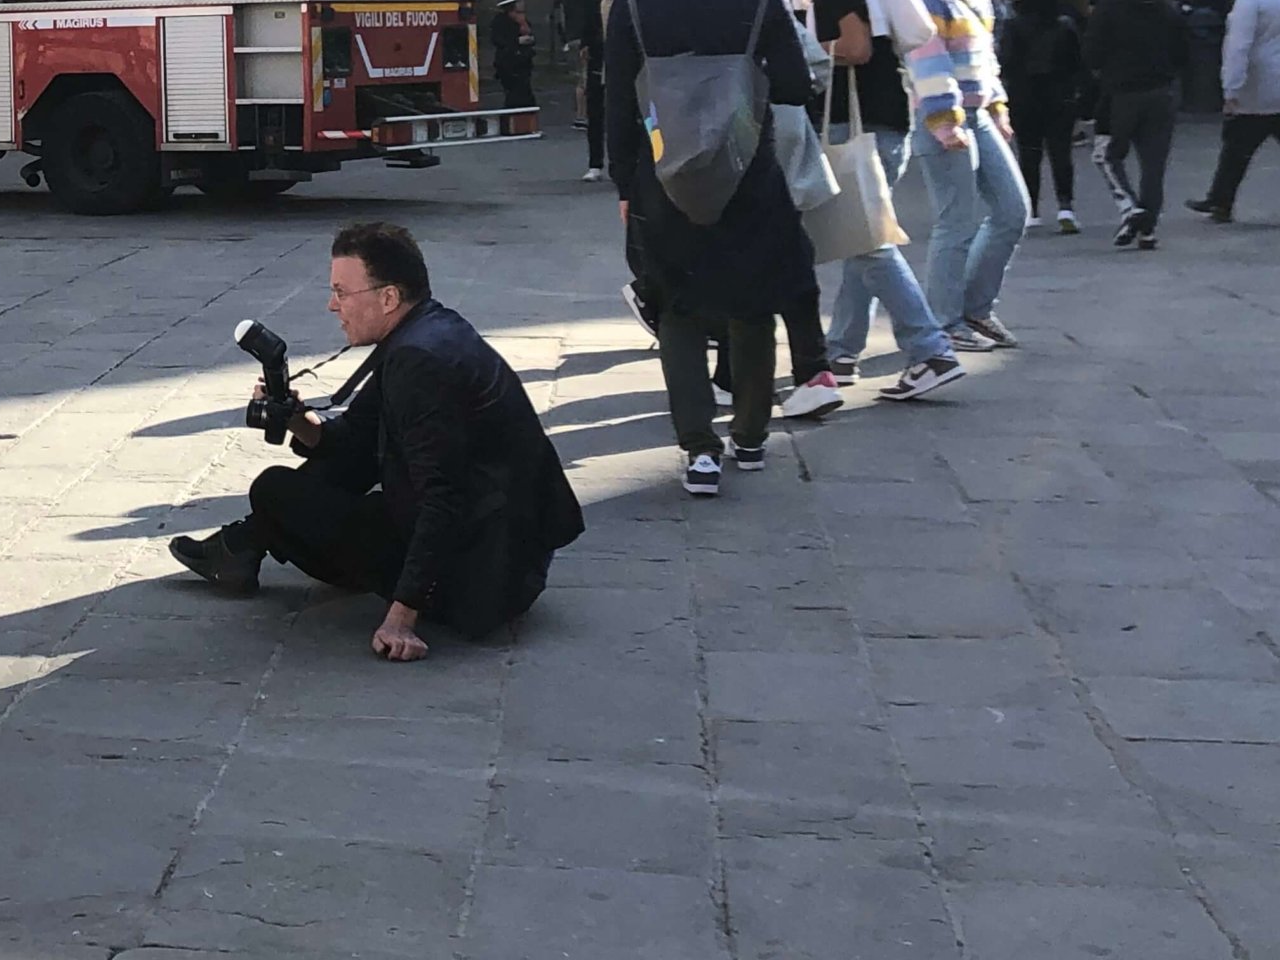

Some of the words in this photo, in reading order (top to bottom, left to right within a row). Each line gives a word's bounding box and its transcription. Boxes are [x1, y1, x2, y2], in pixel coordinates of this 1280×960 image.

[55, 18, 105, 29] MAGIRUS
[354, 11, 384, 28] VIGILI
[385, 11, 404, 27] DEL
[406, 10, 439, 27] FUOCO
